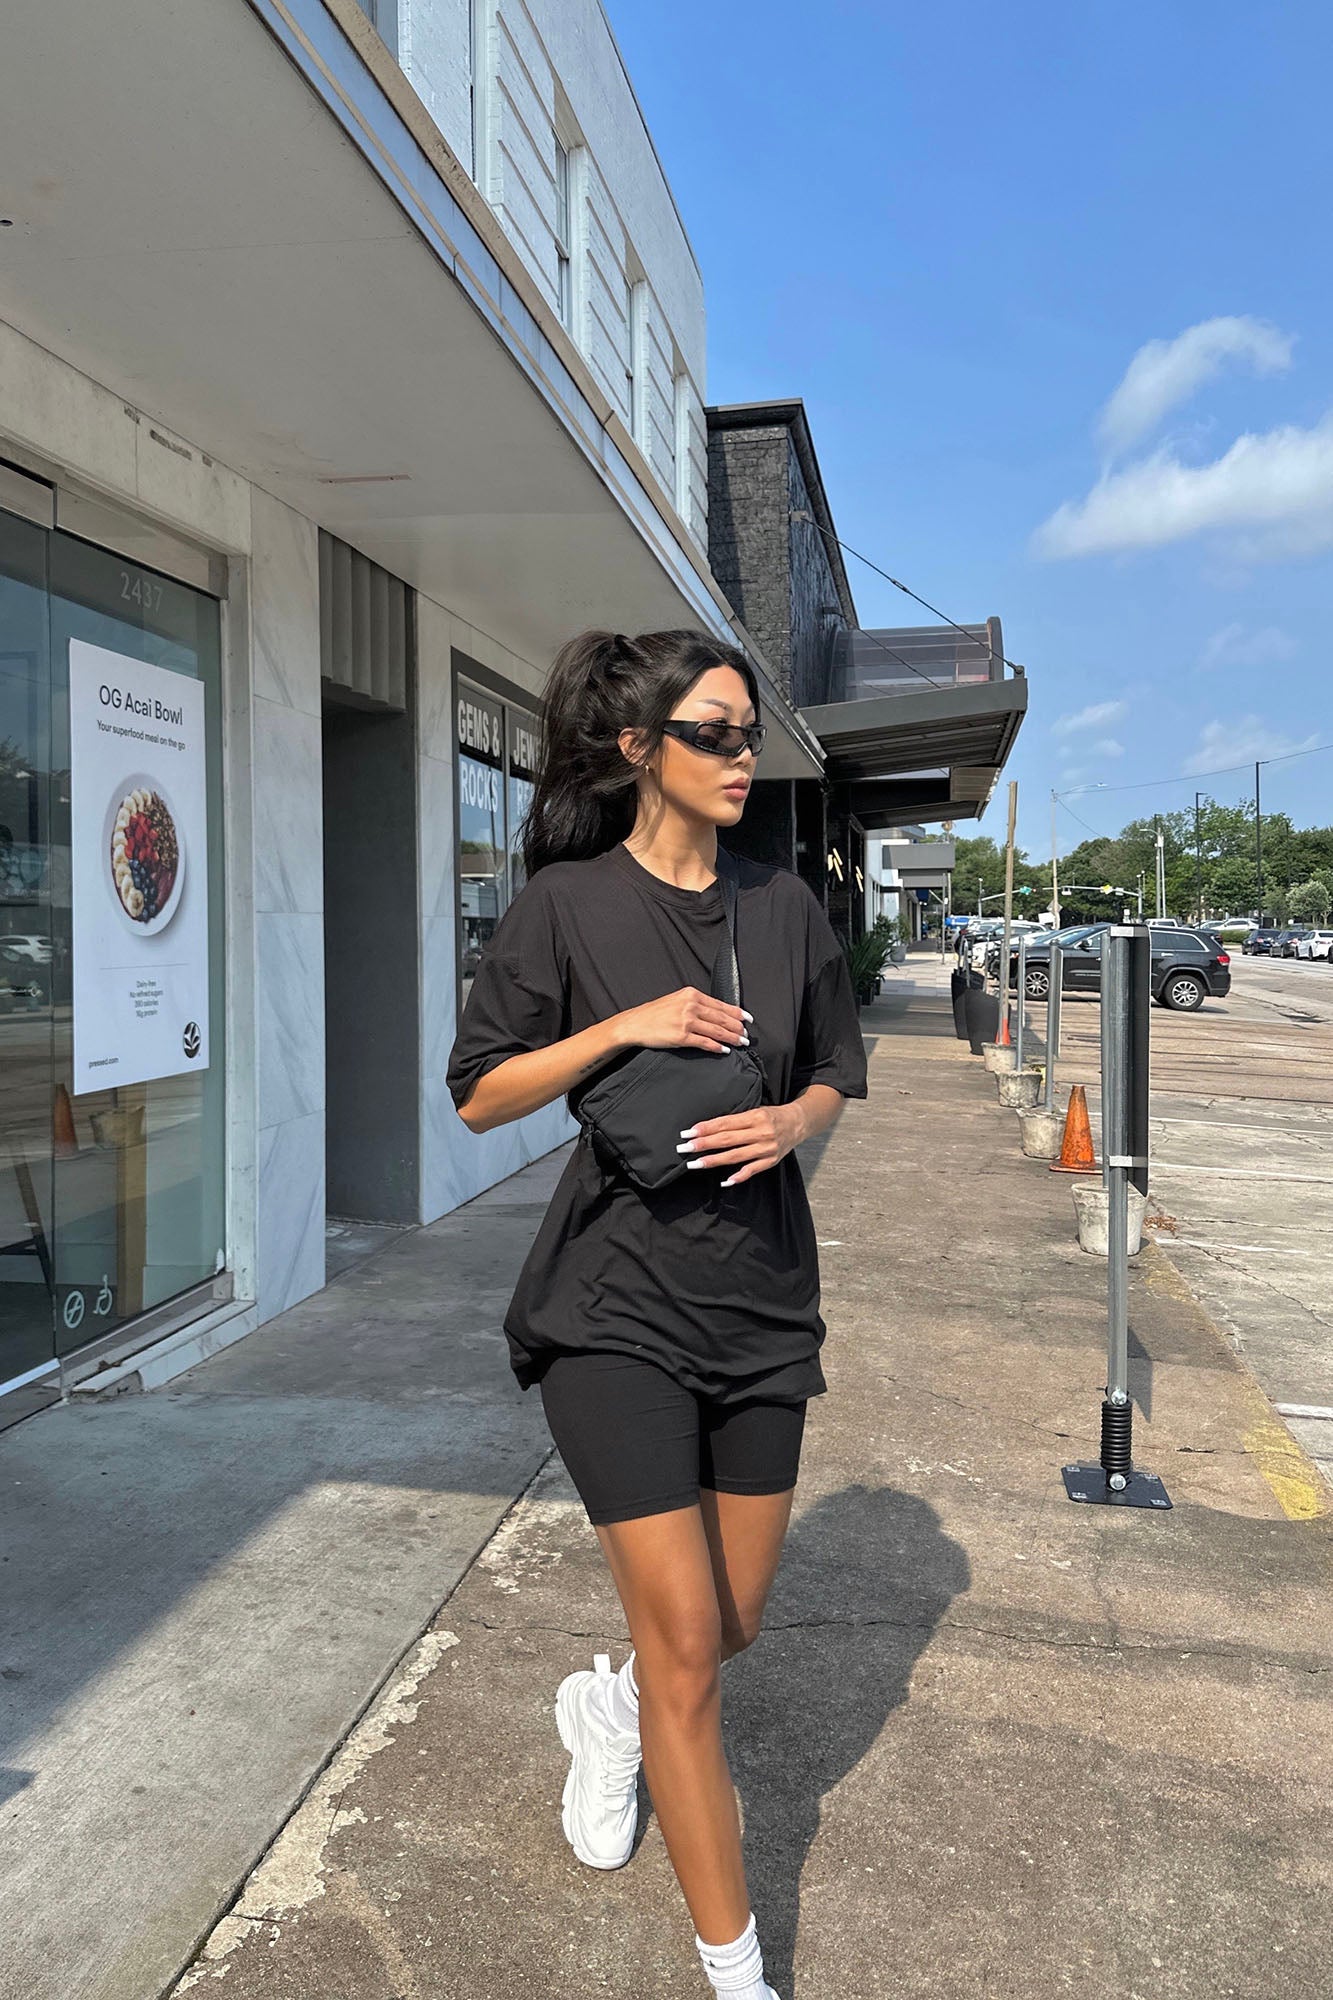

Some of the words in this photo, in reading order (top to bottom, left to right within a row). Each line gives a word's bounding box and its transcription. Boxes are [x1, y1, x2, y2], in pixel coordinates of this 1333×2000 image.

[121, 571, 162, 612] 2437
[99, 685, 122, 709] OG
[125, 692, 152, 718] Acai
[155, 700, 183, 726] Bowl
[97, 719, 112, 732] Your
[112, 726, 145, 741] superfood
[145, 733, 159, 744] meal
[160, 737, 168, 747] on
[168, 738, 177, 748] the
[178, 742, 186, 752] go
[458, 699, 489, 754] GEMS
[492, 716, 500, 758] &
[460, 761, 499, 813] ROCKS
